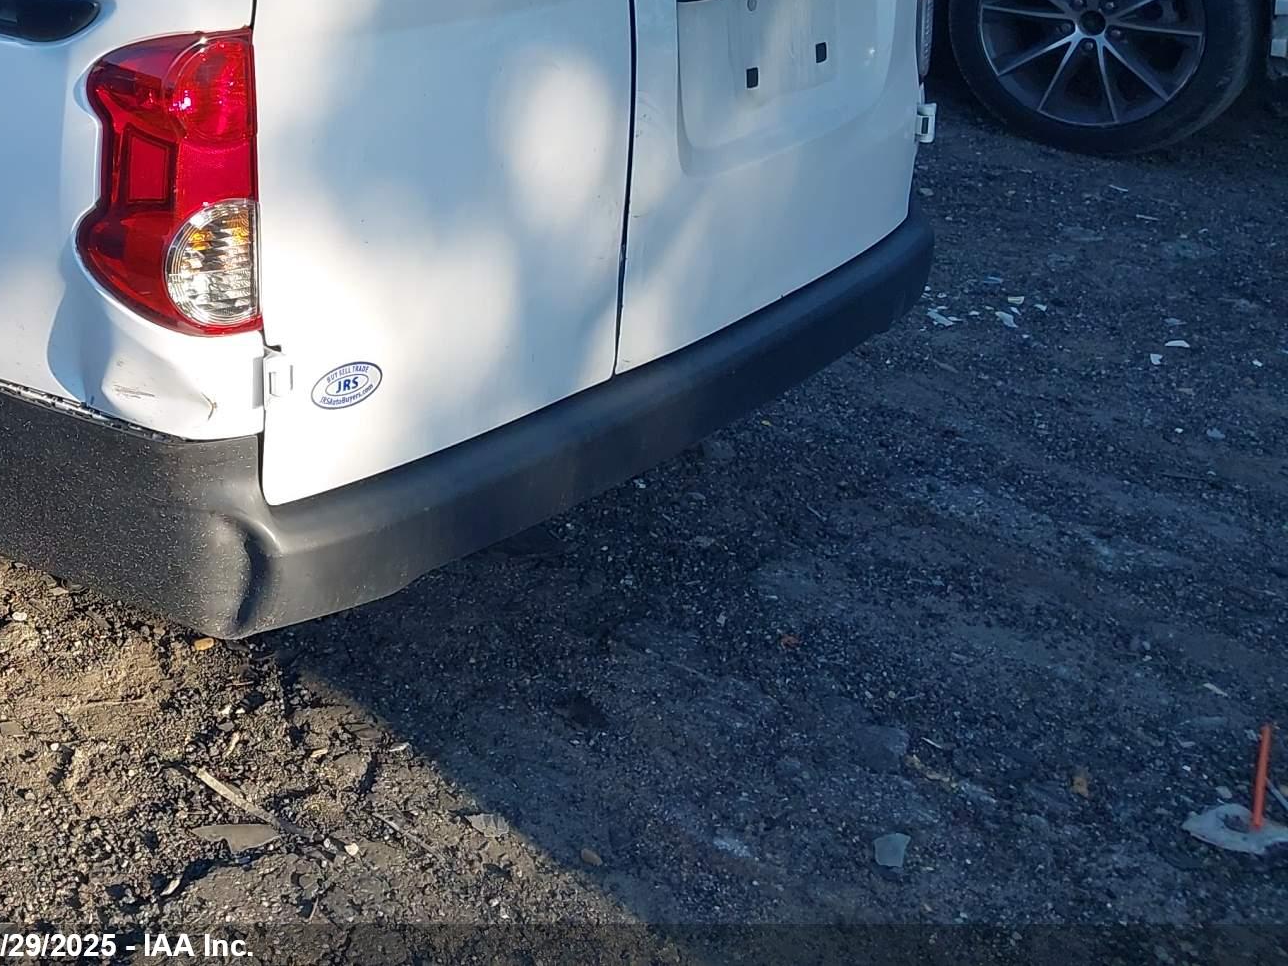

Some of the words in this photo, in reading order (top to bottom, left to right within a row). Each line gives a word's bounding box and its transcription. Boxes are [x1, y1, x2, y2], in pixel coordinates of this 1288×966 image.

[326, 372, 339, 384] BUY
[338, 366, 351, 377] SELL
[352, 365, 369, 373] TRADE
[335, 376, 359, 394] JRS
